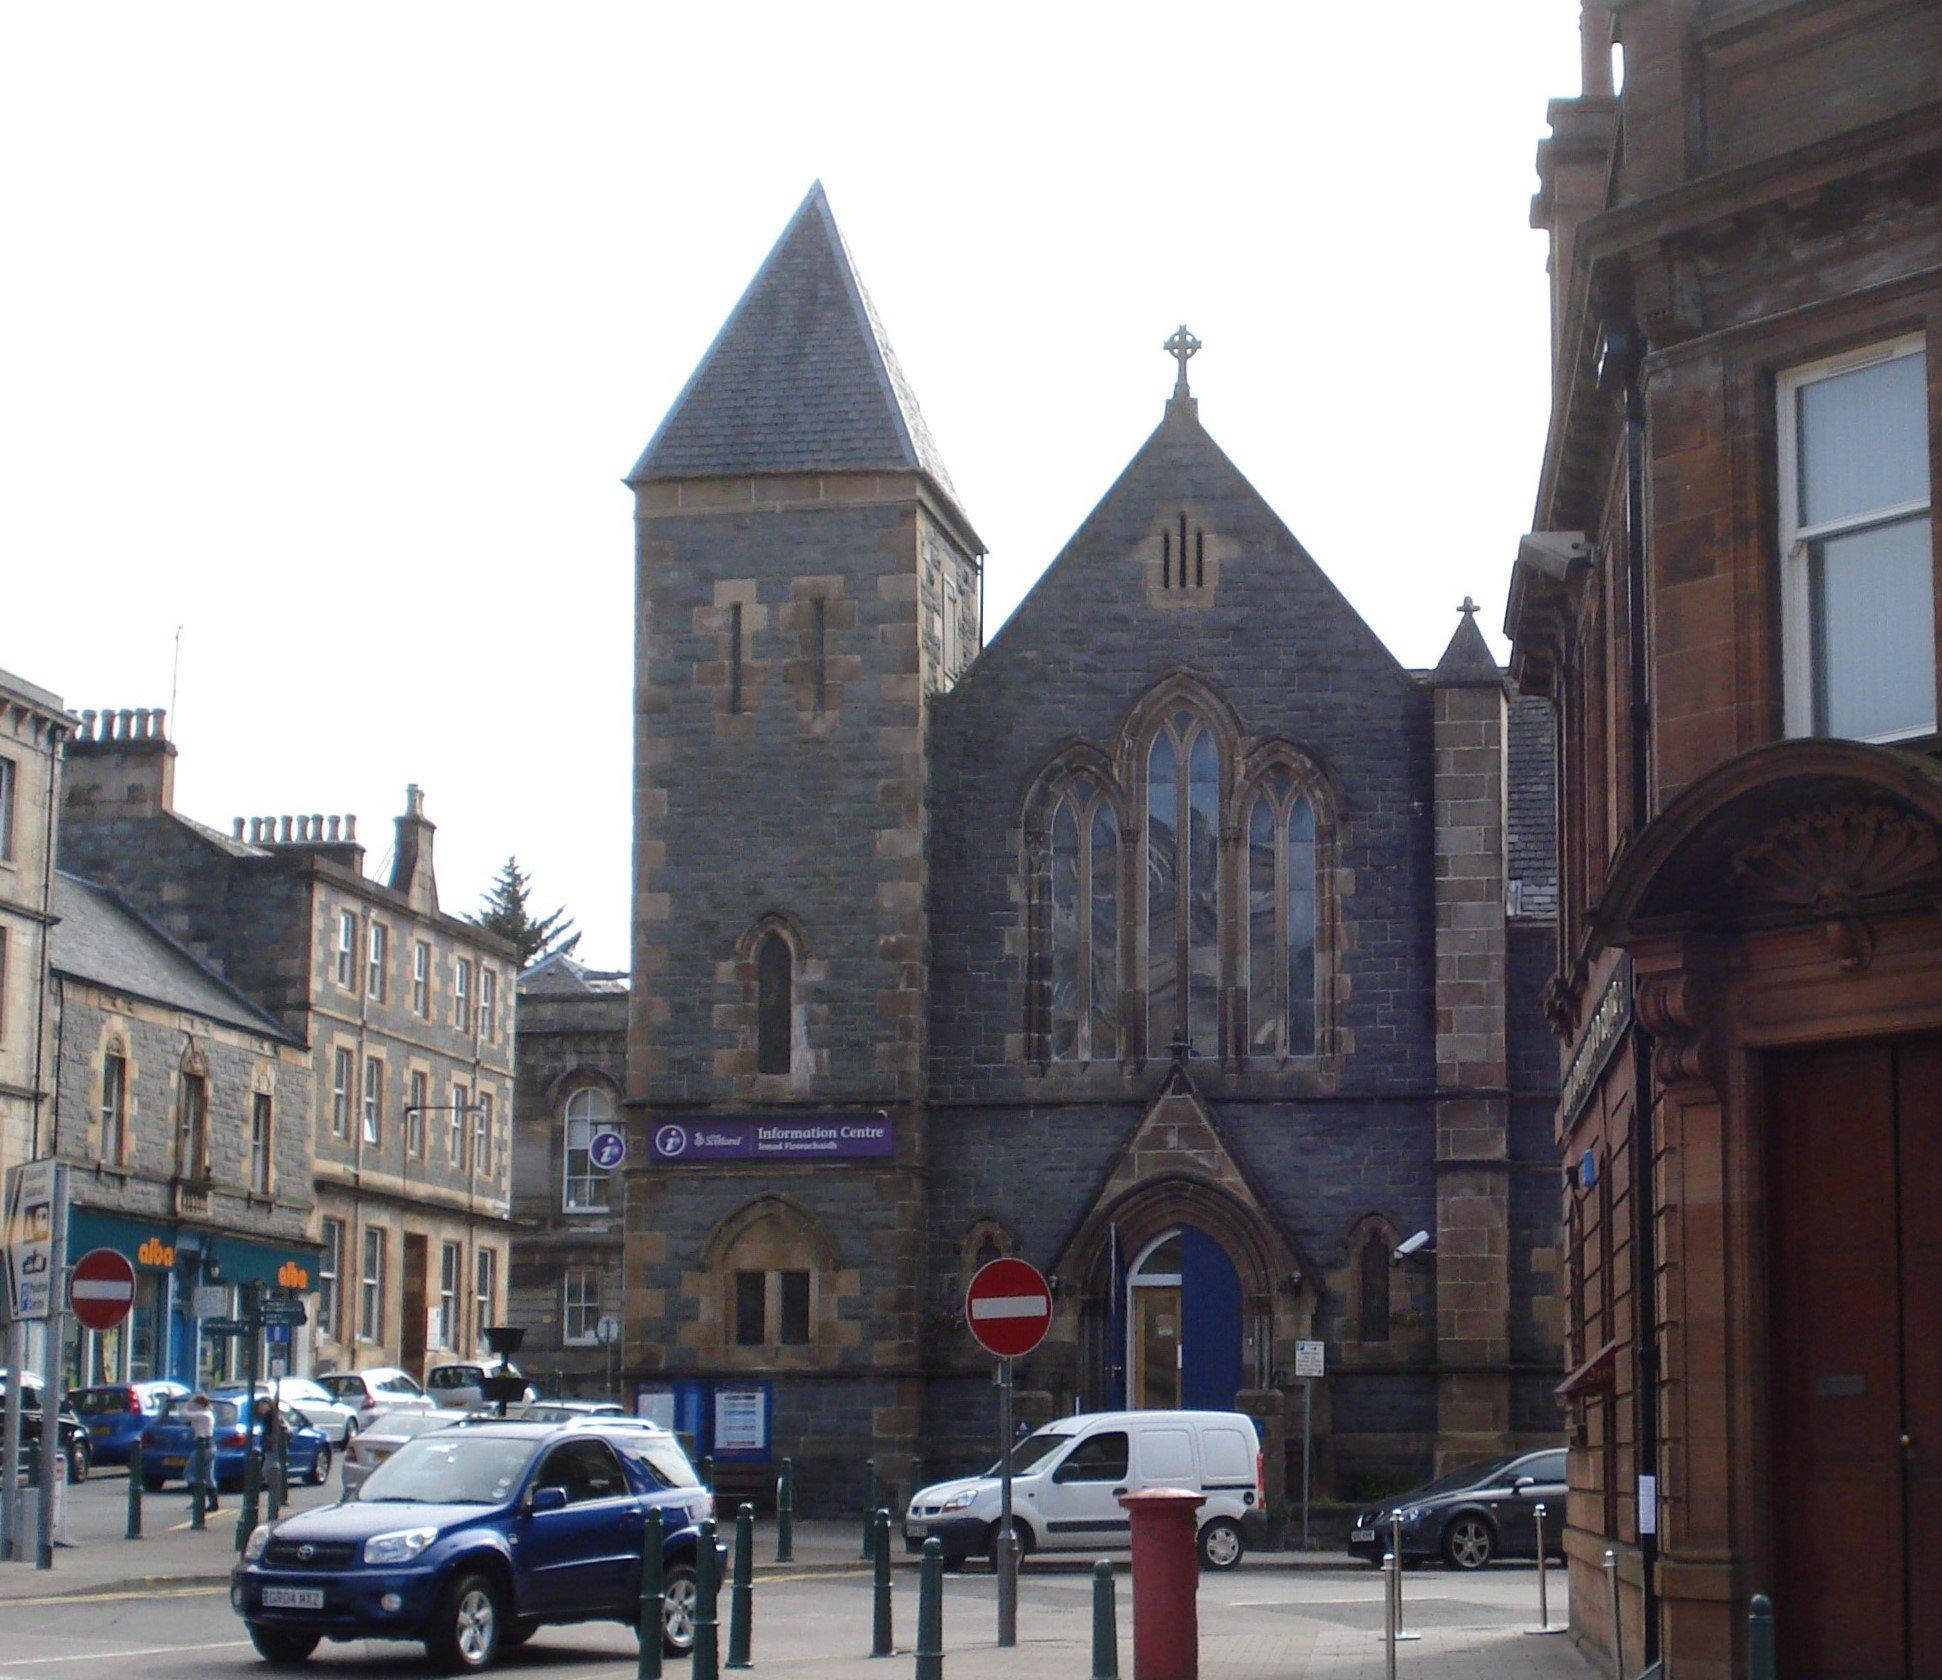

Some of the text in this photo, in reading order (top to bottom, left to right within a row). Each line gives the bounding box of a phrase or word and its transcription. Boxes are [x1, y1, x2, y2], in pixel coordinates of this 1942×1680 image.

[758, 1126, 884, 1139] Information Centre
[138, 1237, 174, 1267] alba
